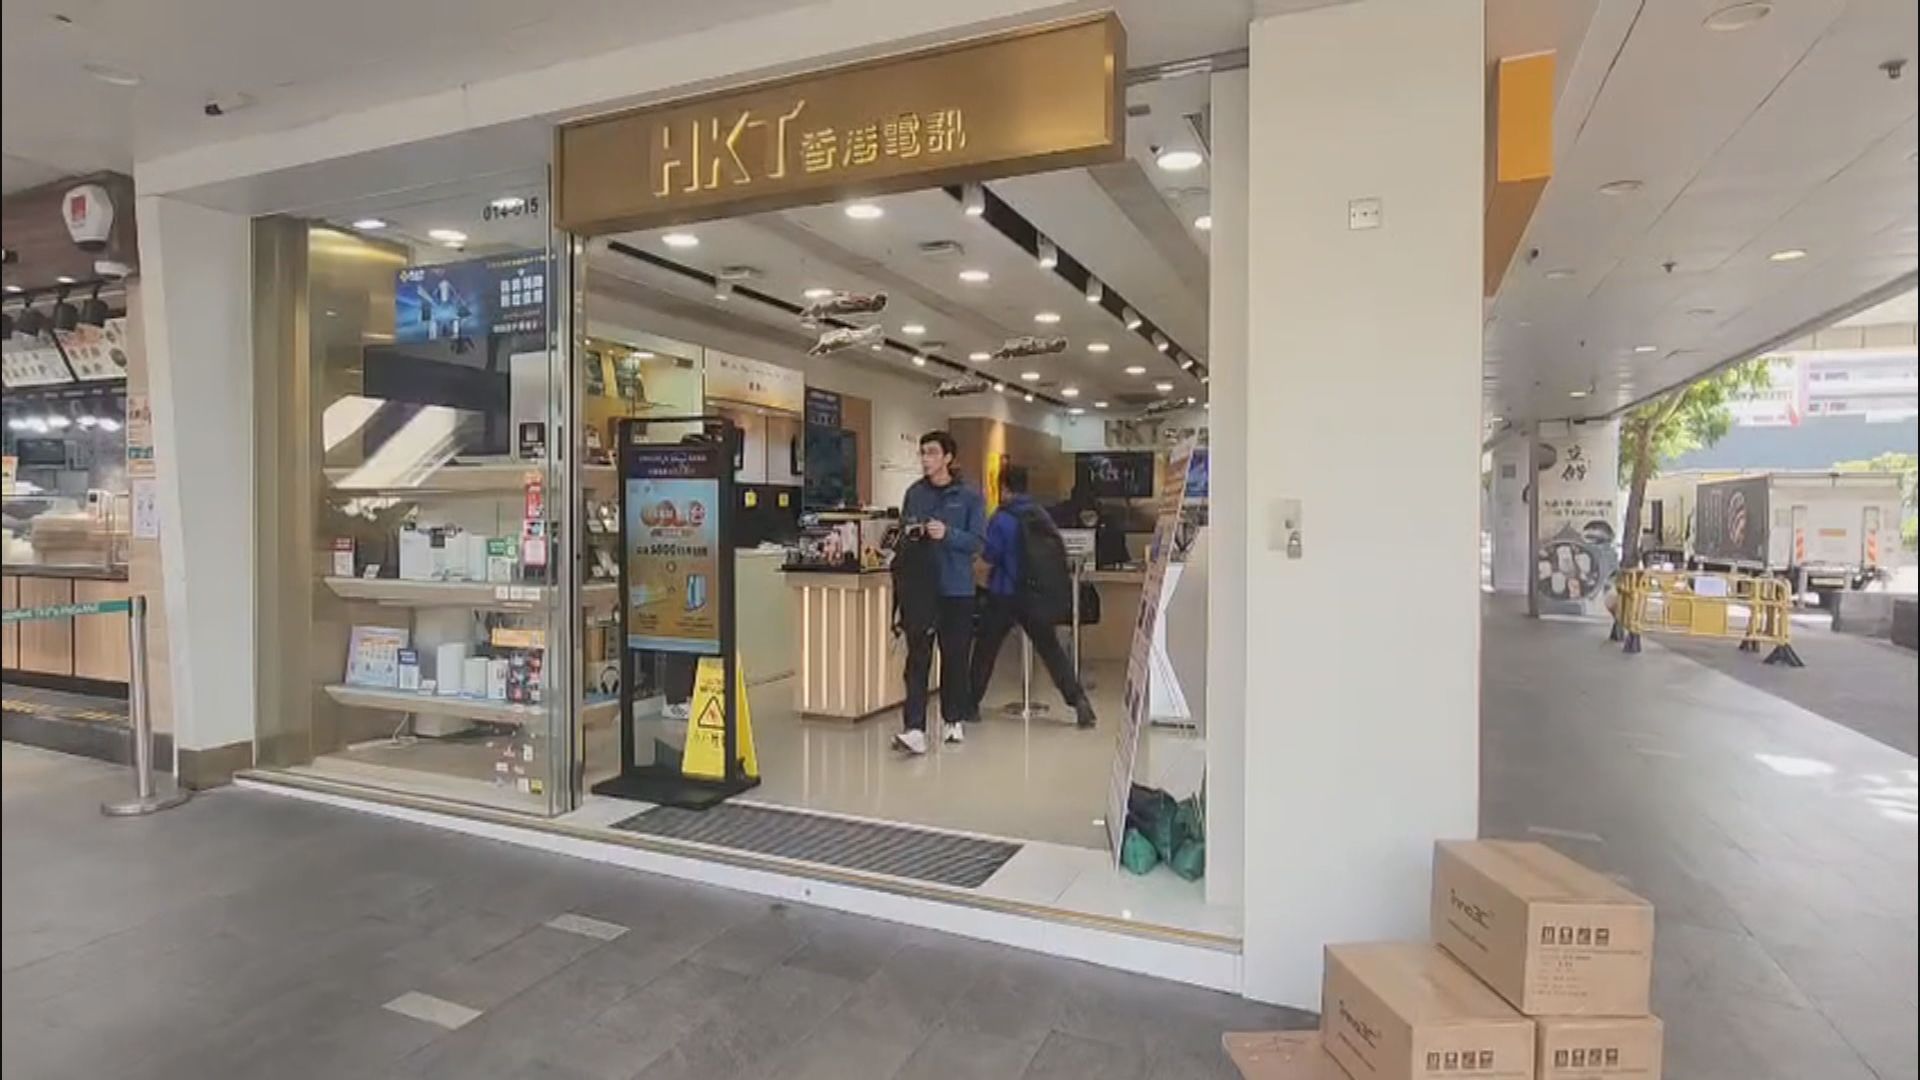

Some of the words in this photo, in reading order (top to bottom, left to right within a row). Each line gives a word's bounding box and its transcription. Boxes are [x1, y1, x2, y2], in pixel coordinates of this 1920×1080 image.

[653, 100, 805, 197] HKT
[802, 110, 967, 173] 香港電訊
